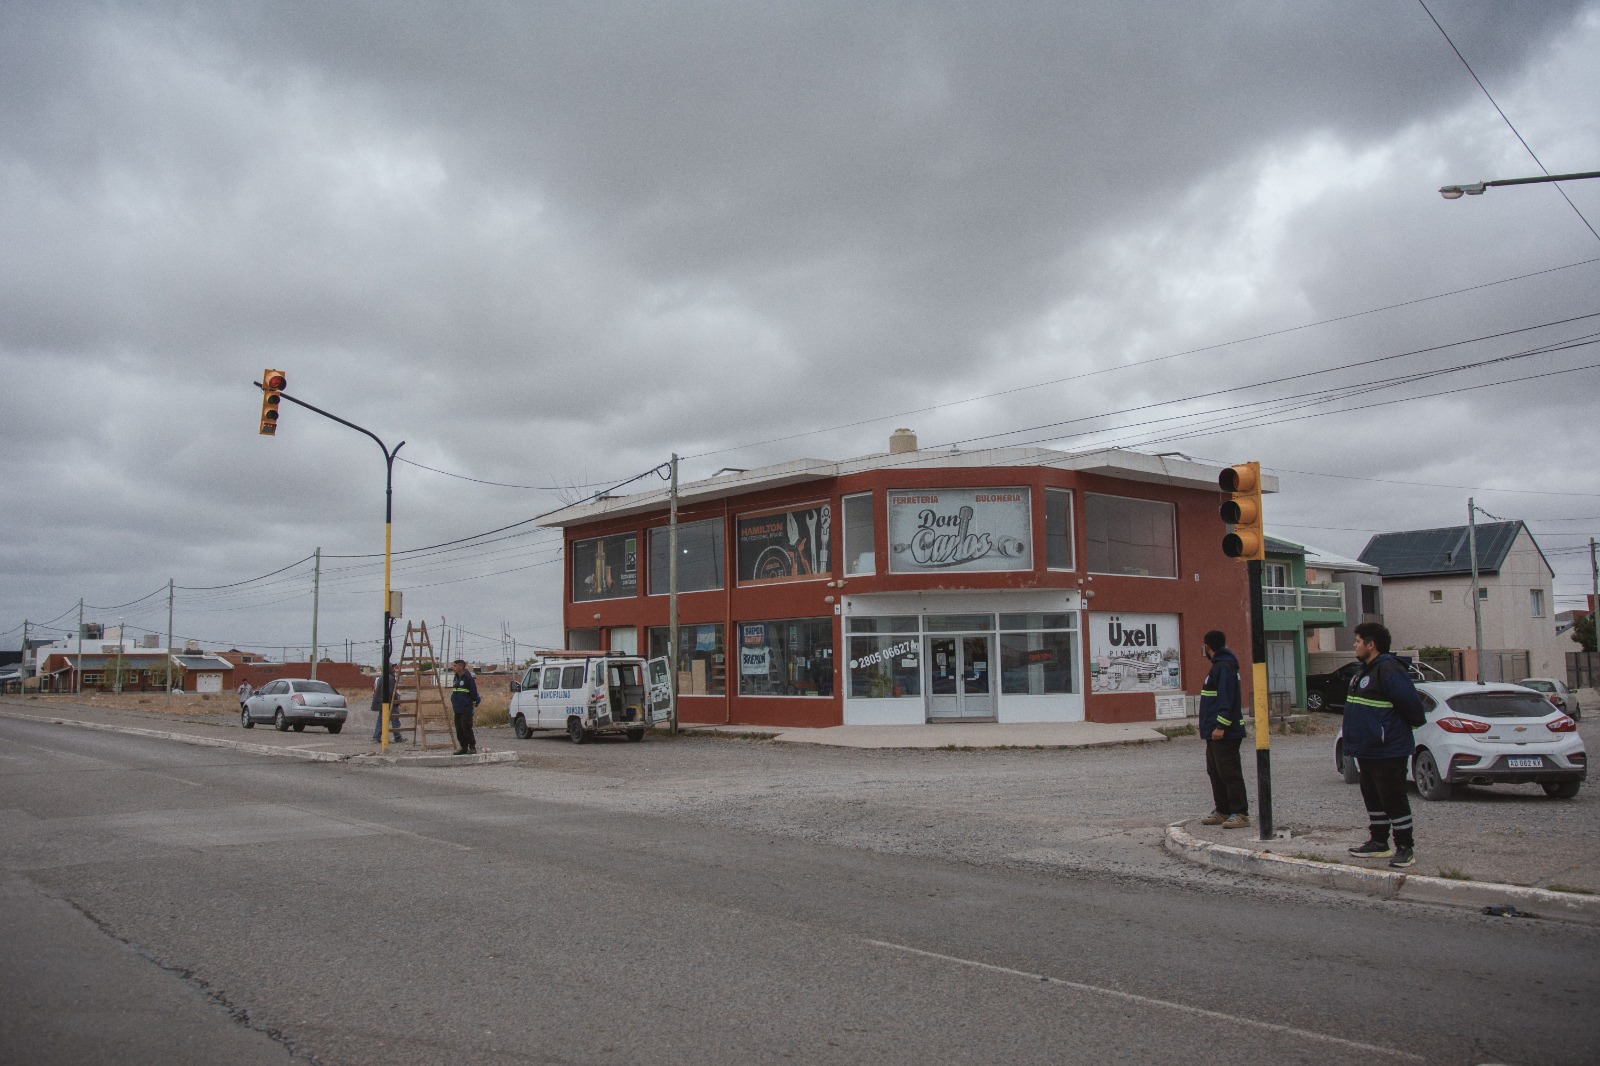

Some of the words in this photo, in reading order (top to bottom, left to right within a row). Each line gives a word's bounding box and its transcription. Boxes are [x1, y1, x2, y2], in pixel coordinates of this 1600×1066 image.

[892, 495, 939, 505] FERRETERIA
[975, 494, 1021, 503] BULONERIA
[917, 509, 960, 528] Don
[741, 523, 783, 536] HAMILTON
[910, 518, 992, 564] Carlos
[1108, 616, 1158, 646] Üxell
[858, 652, 881, 668] 2805
